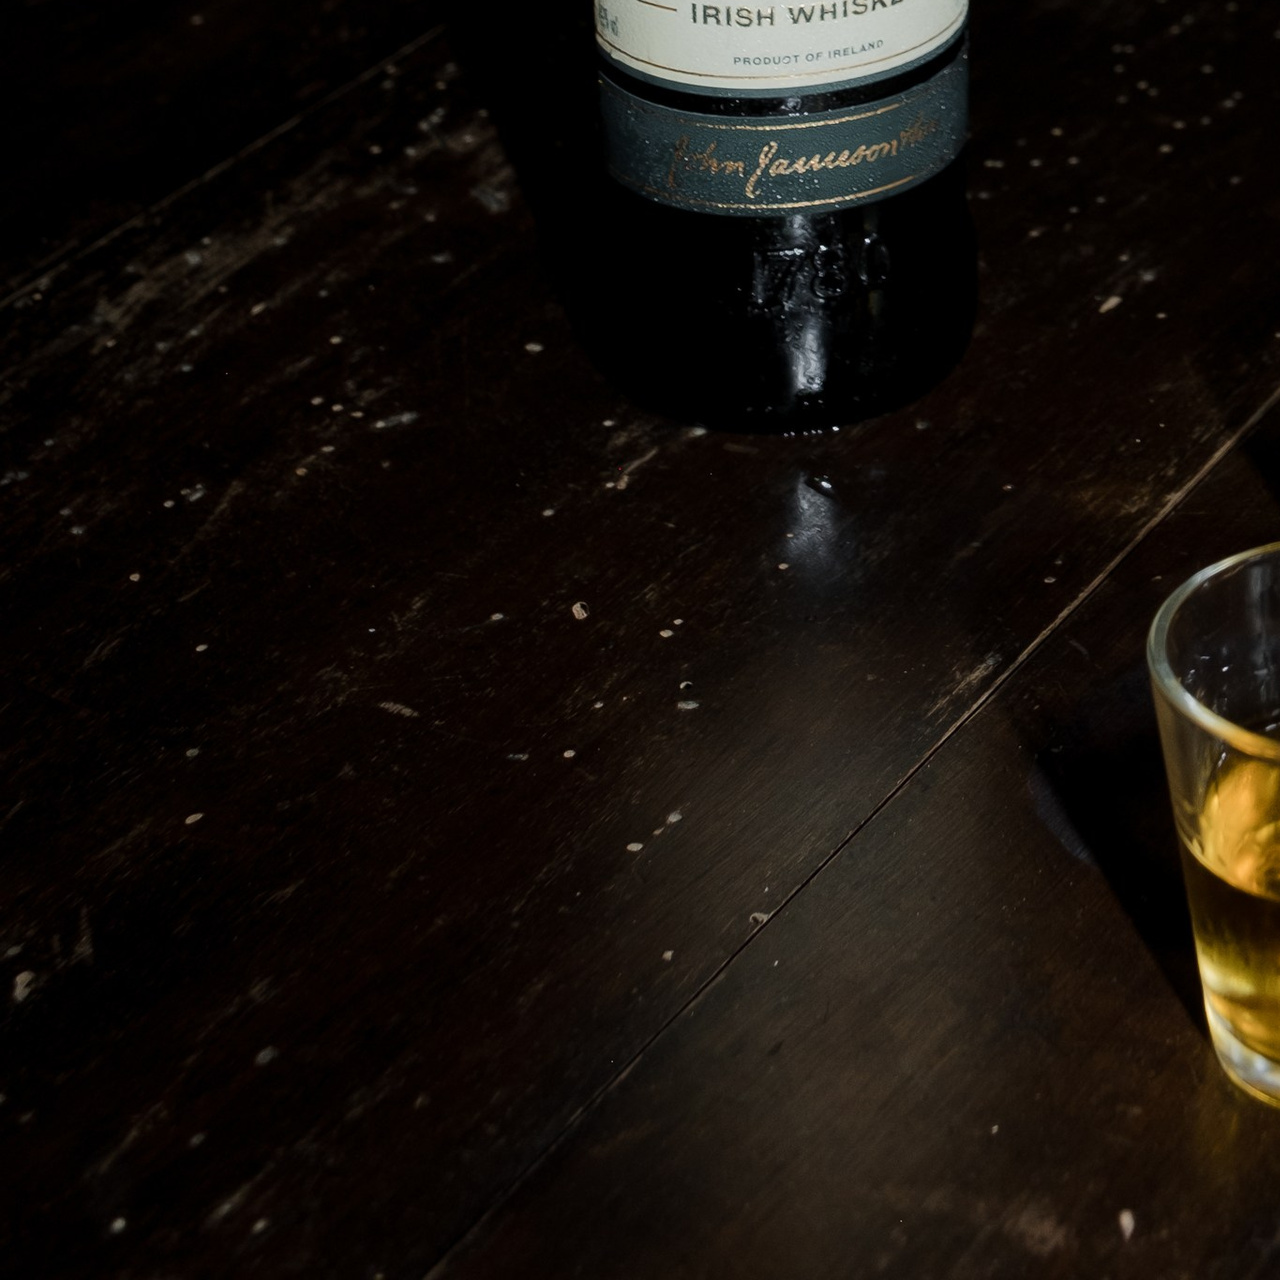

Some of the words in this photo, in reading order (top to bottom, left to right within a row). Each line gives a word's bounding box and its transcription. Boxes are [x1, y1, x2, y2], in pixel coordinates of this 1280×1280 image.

[691, 2, 775, 27] IRISH
[733, 55, 800, 66] PRODUCT
[805, 52, 822, 63] OF
[828, 39, 884, 59] IRELAND
[745, 139, 898, 199] Jameson
